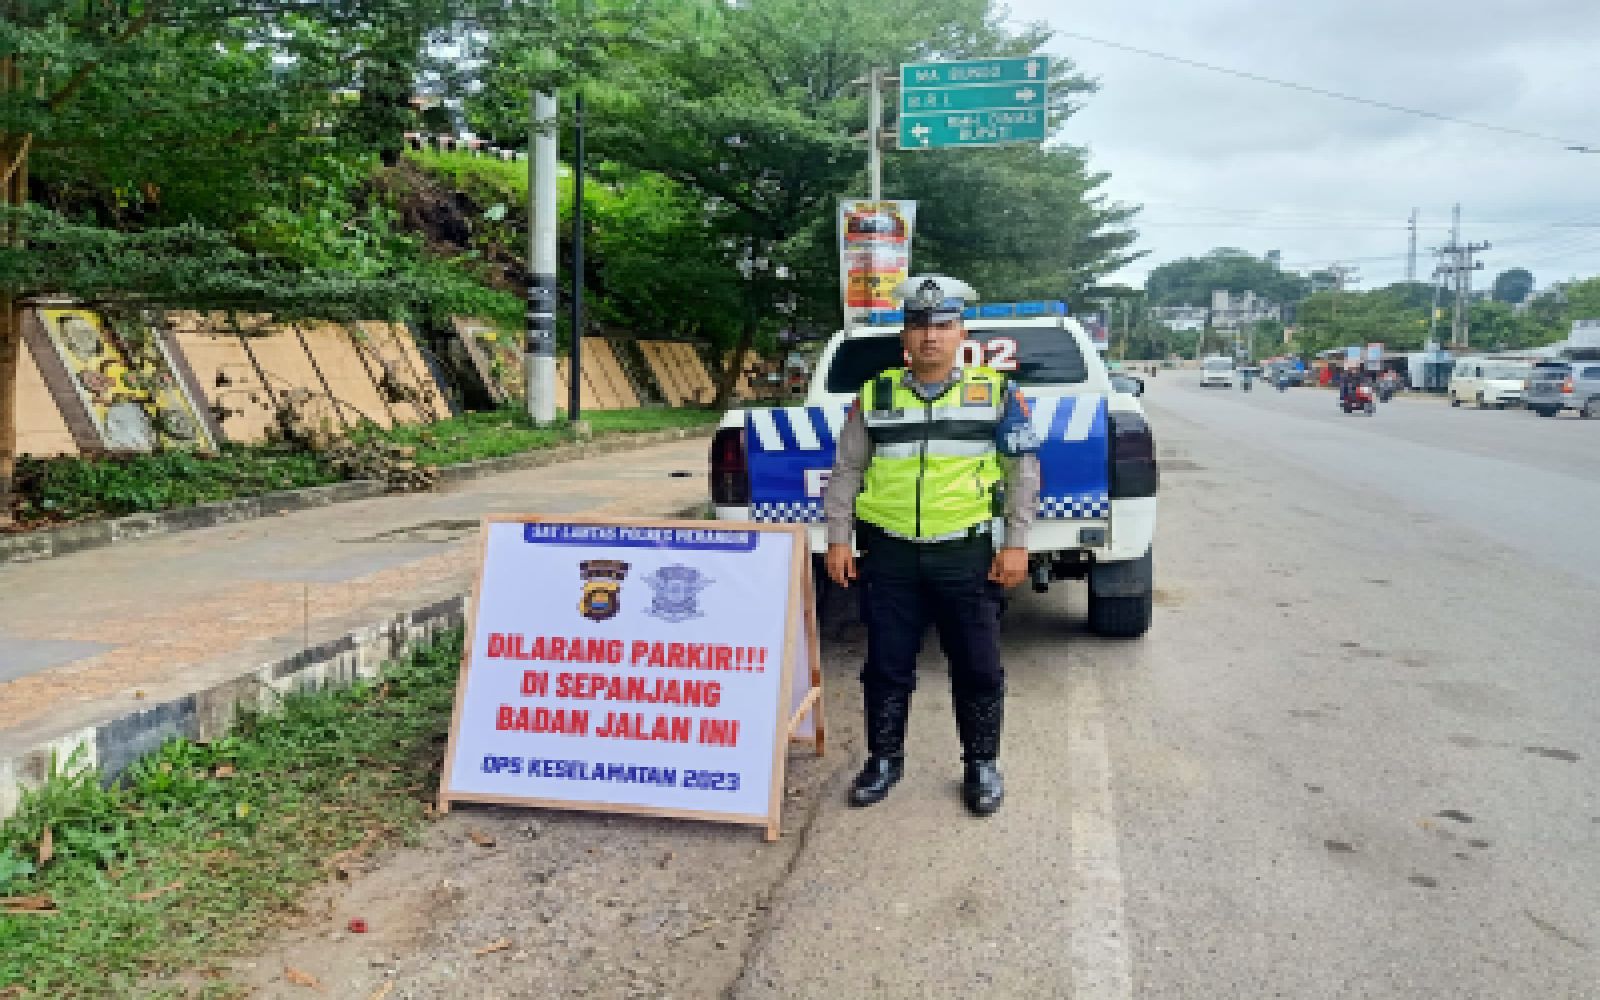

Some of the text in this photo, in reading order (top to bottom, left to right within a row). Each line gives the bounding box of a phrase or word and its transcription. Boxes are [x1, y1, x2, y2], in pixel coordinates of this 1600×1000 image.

[486, 633, 767, 672] DILARANG PARKIR!!!
[520, 670, 720, 706] DI SEPANJANG
[495, 704, 741, 748] BADAN JALAN INI
[482, 754, 740, 790] OPS KESELAMATAN 2023
